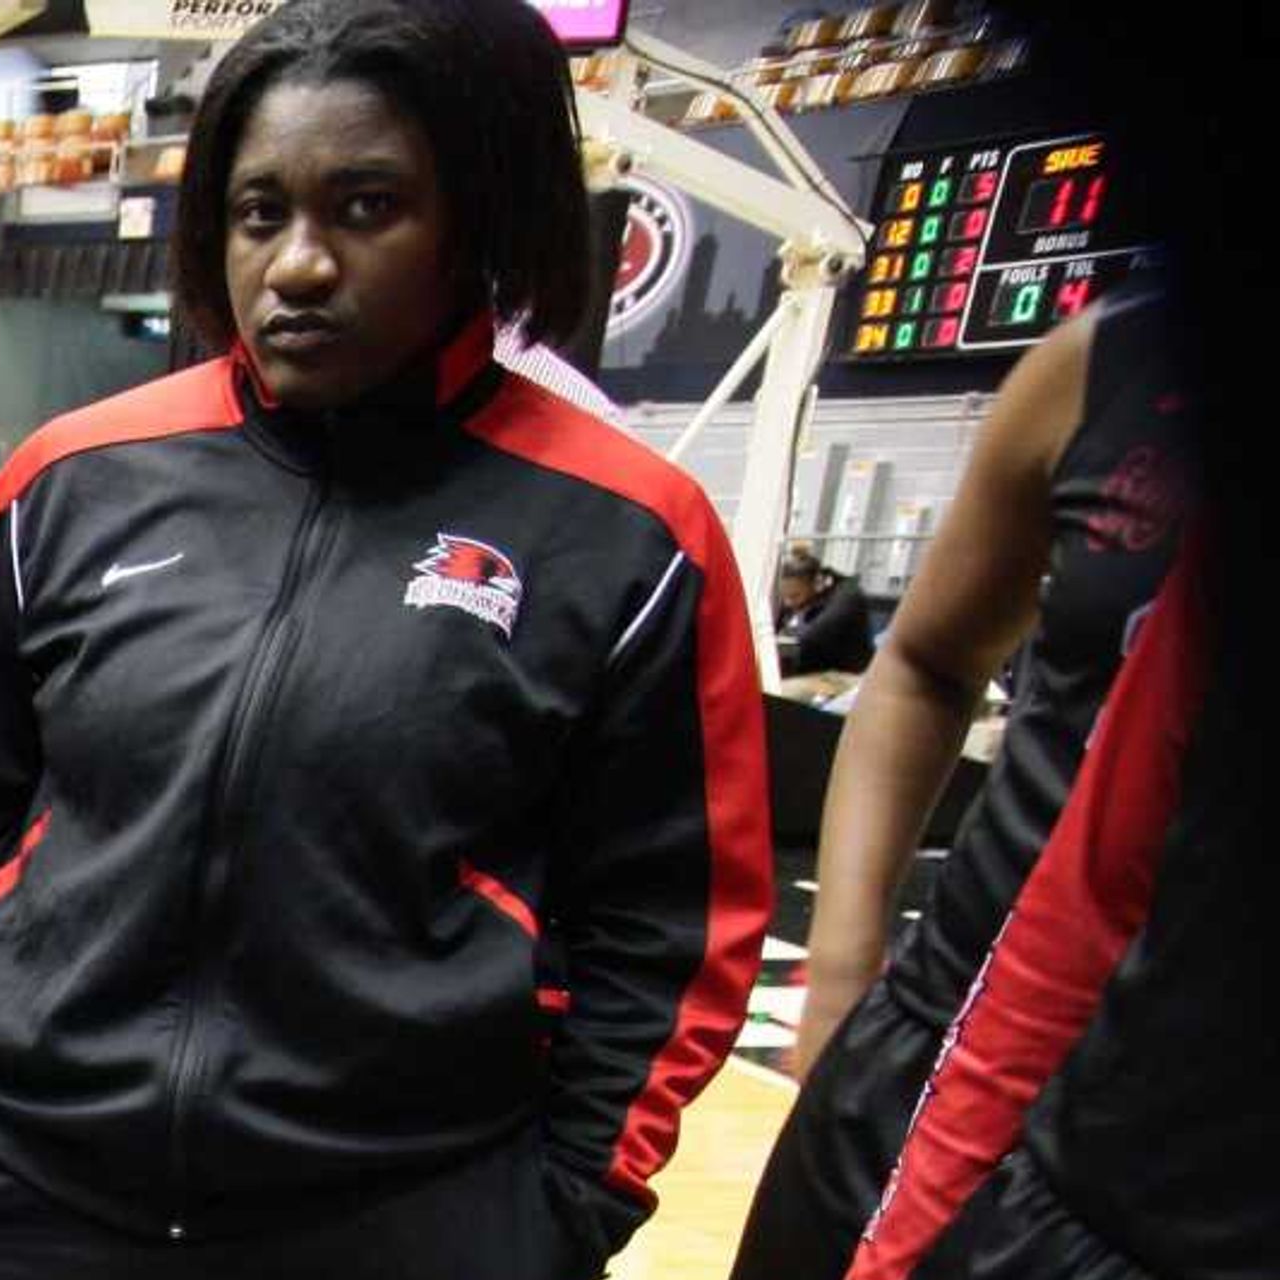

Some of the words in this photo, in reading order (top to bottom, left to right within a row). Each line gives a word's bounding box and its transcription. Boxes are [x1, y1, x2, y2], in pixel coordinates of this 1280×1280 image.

[970, 149, 1000, 170] PTS
[899, 183, 924, 211] 0
[928, 177, 952, 207] 0
[1048, 176, 1108, 226] 11
[919, 216, 941, 244] 0
[963, 210, 988, 237] 0
[1033, 231, 1090, 254] BONUS
[910, 252, 931, 280] 0
[998, 264, 1049, 285] FOULS
[1063, 258, 1097, 279] TOL
[946, 282, 968, 309] 0
[1011, 284, 1040, 321] 0
[894, 321, 916, 348] 0
[935, 316, 959, 346] 0
